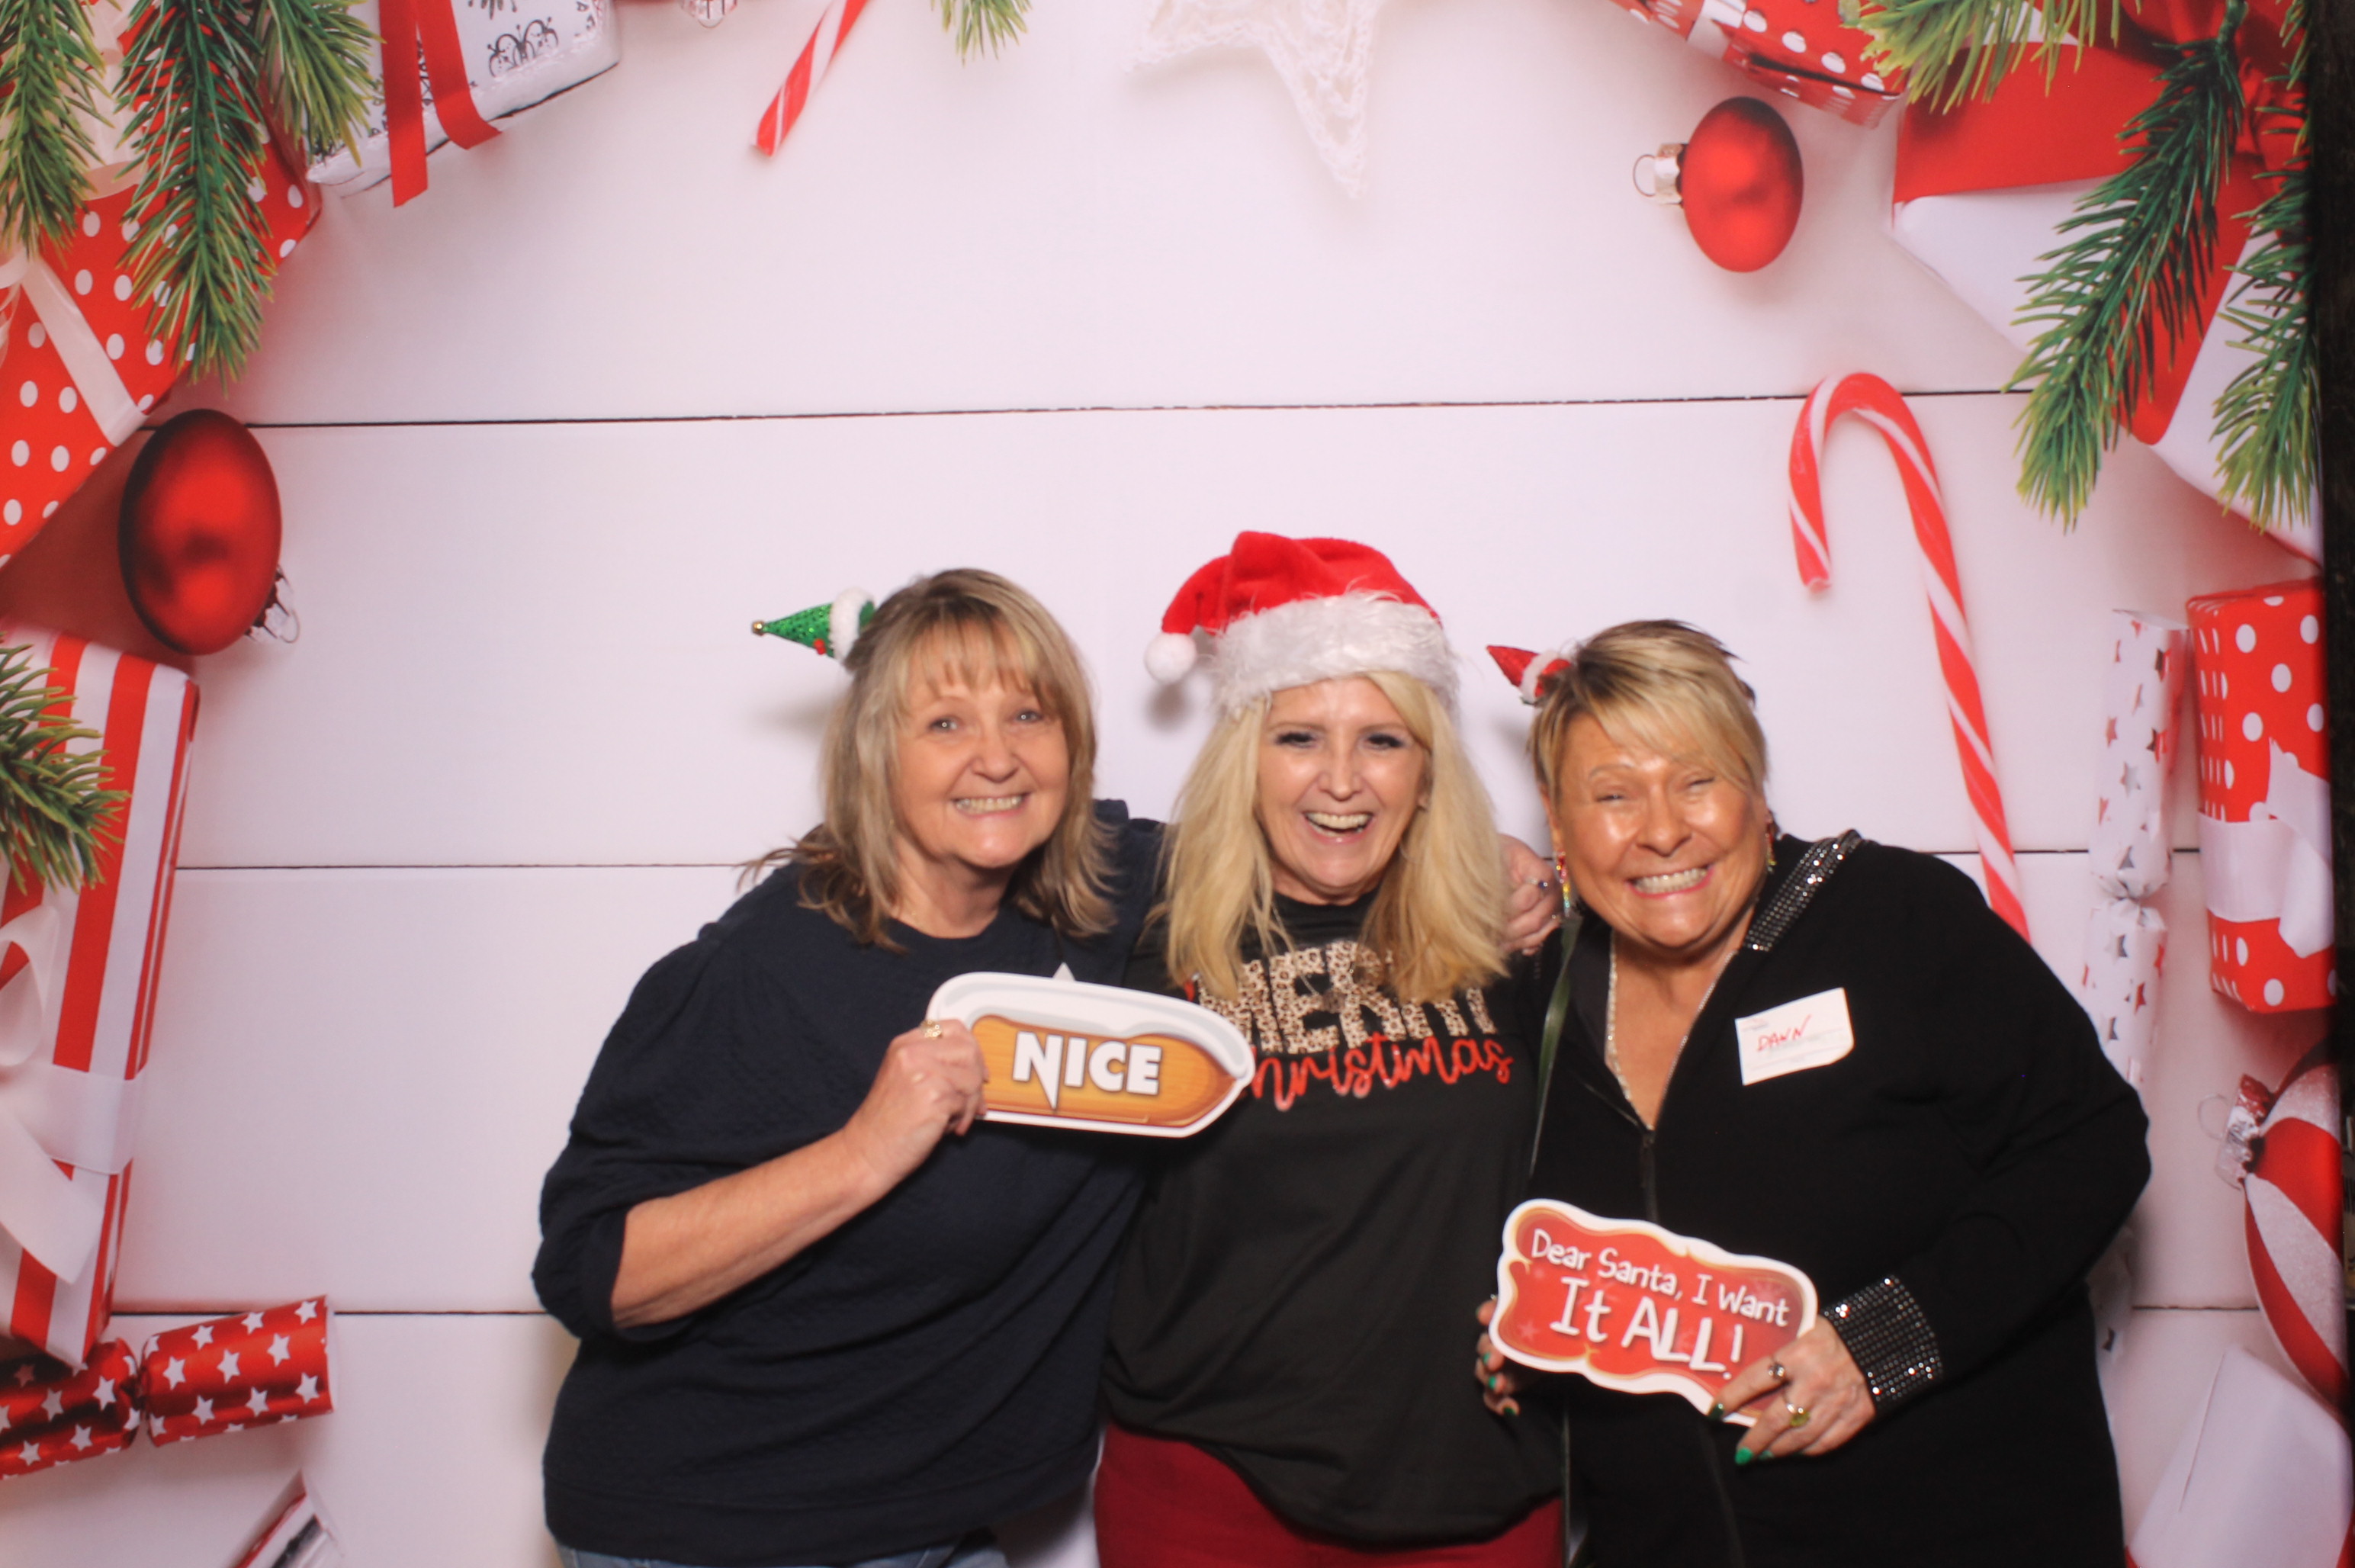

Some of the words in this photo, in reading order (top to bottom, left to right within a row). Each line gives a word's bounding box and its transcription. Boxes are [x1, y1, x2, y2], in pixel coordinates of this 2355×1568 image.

[1199, 940, 1499, 1055] MER
[1756, 1014, 1812, 1052] DAWN
[1013, 1030, 1162, 1110] NICE
[1250, 1032, 1514, 1112] hristmas
[1531, 1228, 1592, 1271] Dear
[1597, 1248, 1683, 1301] Santa,
[1691, 1274, 1713, 1306] I
[1718, 1284, 1790, 1327] Want
[1550, 1276, 1611, 1343] It
[1621, 1296, 1744, 1380] ALL!
